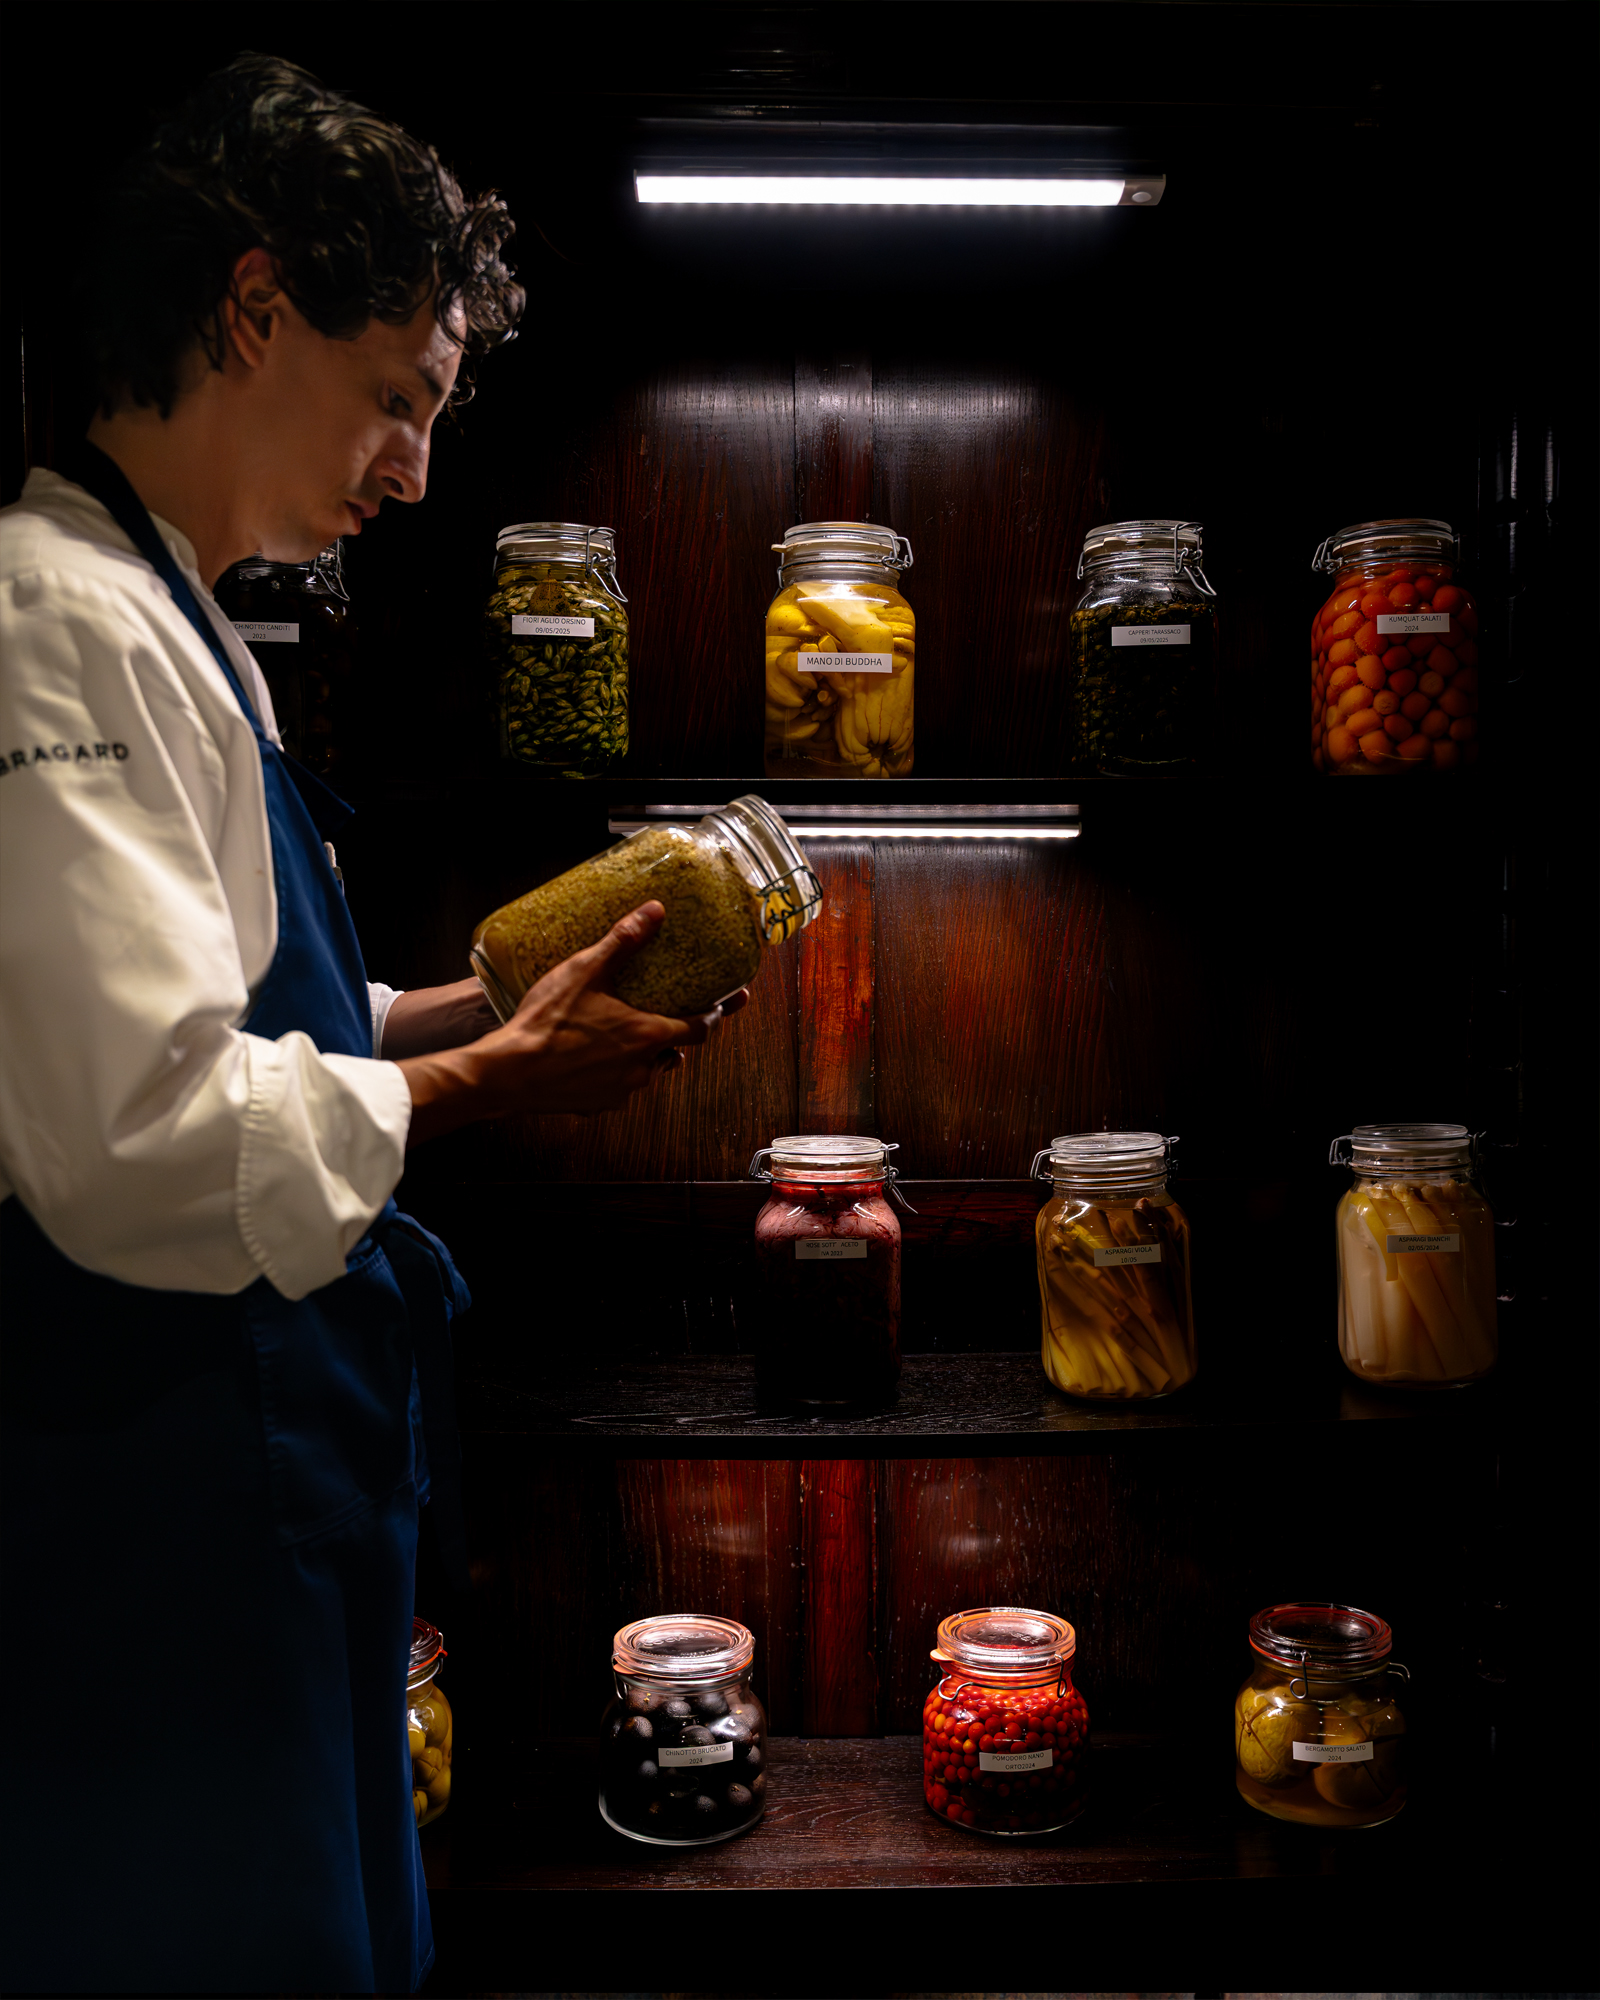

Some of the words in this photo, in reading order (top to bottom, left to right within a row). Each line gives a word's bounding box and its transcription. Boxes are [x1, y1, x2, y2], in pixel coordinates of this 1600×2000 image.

[535, 627, 571, 635] 09/05/2025
[806, 657, 833, 665] MANO
[834, 657, 843, 666] DI
[845, 657, 882, 666] BUDDHA
[1104, 1247, 1134, 1255] ASPARAGI
[698, 1745, 727, 1755] BRUCIATO
[1305, 1745, 1346, 1753] BERGAMOTTO
[1027, 1752, 1045, 1760] NANO
